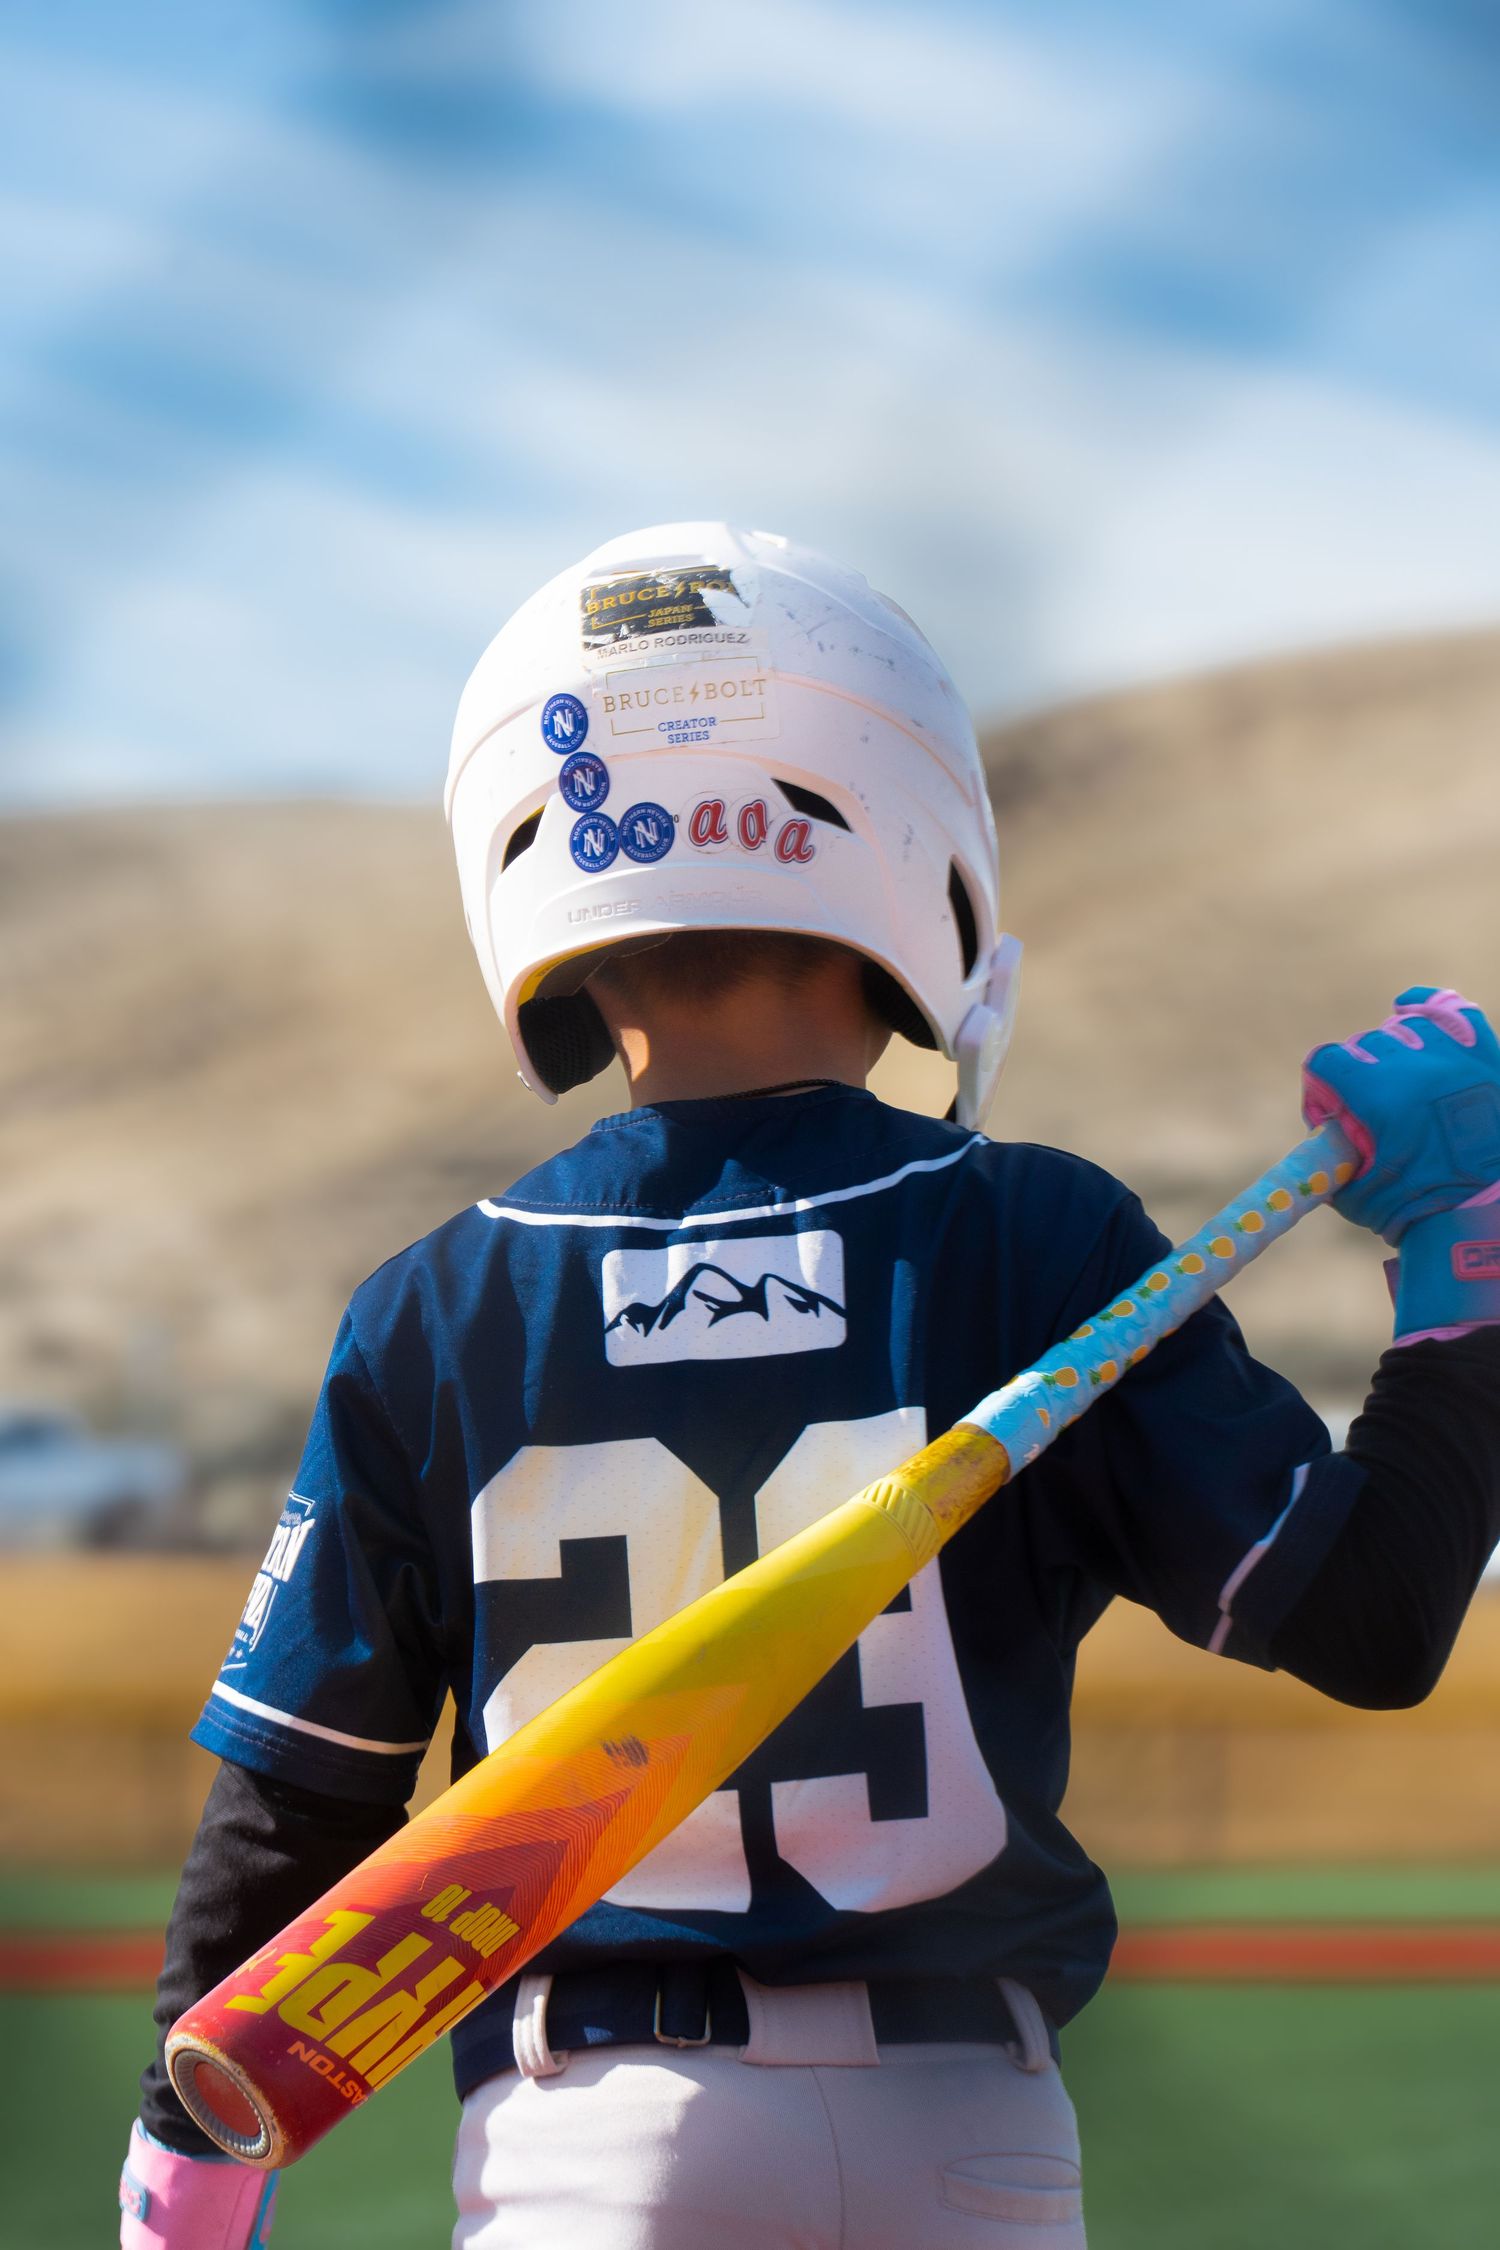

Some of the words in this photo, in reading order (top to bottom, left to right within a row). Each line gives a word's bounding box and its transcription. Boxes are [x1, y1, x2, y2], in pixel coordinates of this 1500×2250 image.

[587, 586, 671, 615] BRUCE
[648, 604, 694, 618] JAPAN
[647, 614, 695, 627] SERIES
[597, 639, 649, 659] MARLO
[654, 632, 750, 649] RODRIGUEZ
[603, 686, 685, 713] BRUCE
[704, 679, 767, 701] BOLT
[552, 708, 574, 739] N
[657, 717, 718, 733] CREATOR
[667, 731, 710, 744] SERIES
[573, 768, 595, 798] N
[583, 828, 606, 857] N
[632, 817, 659, 849] N
[420, 1884, 473, 1923] 10
[448, 1902, 521, 1959] DROP
[224, 1909, 489, 2093] HYPE
[287, 2040, 369, 2105] ASTON
